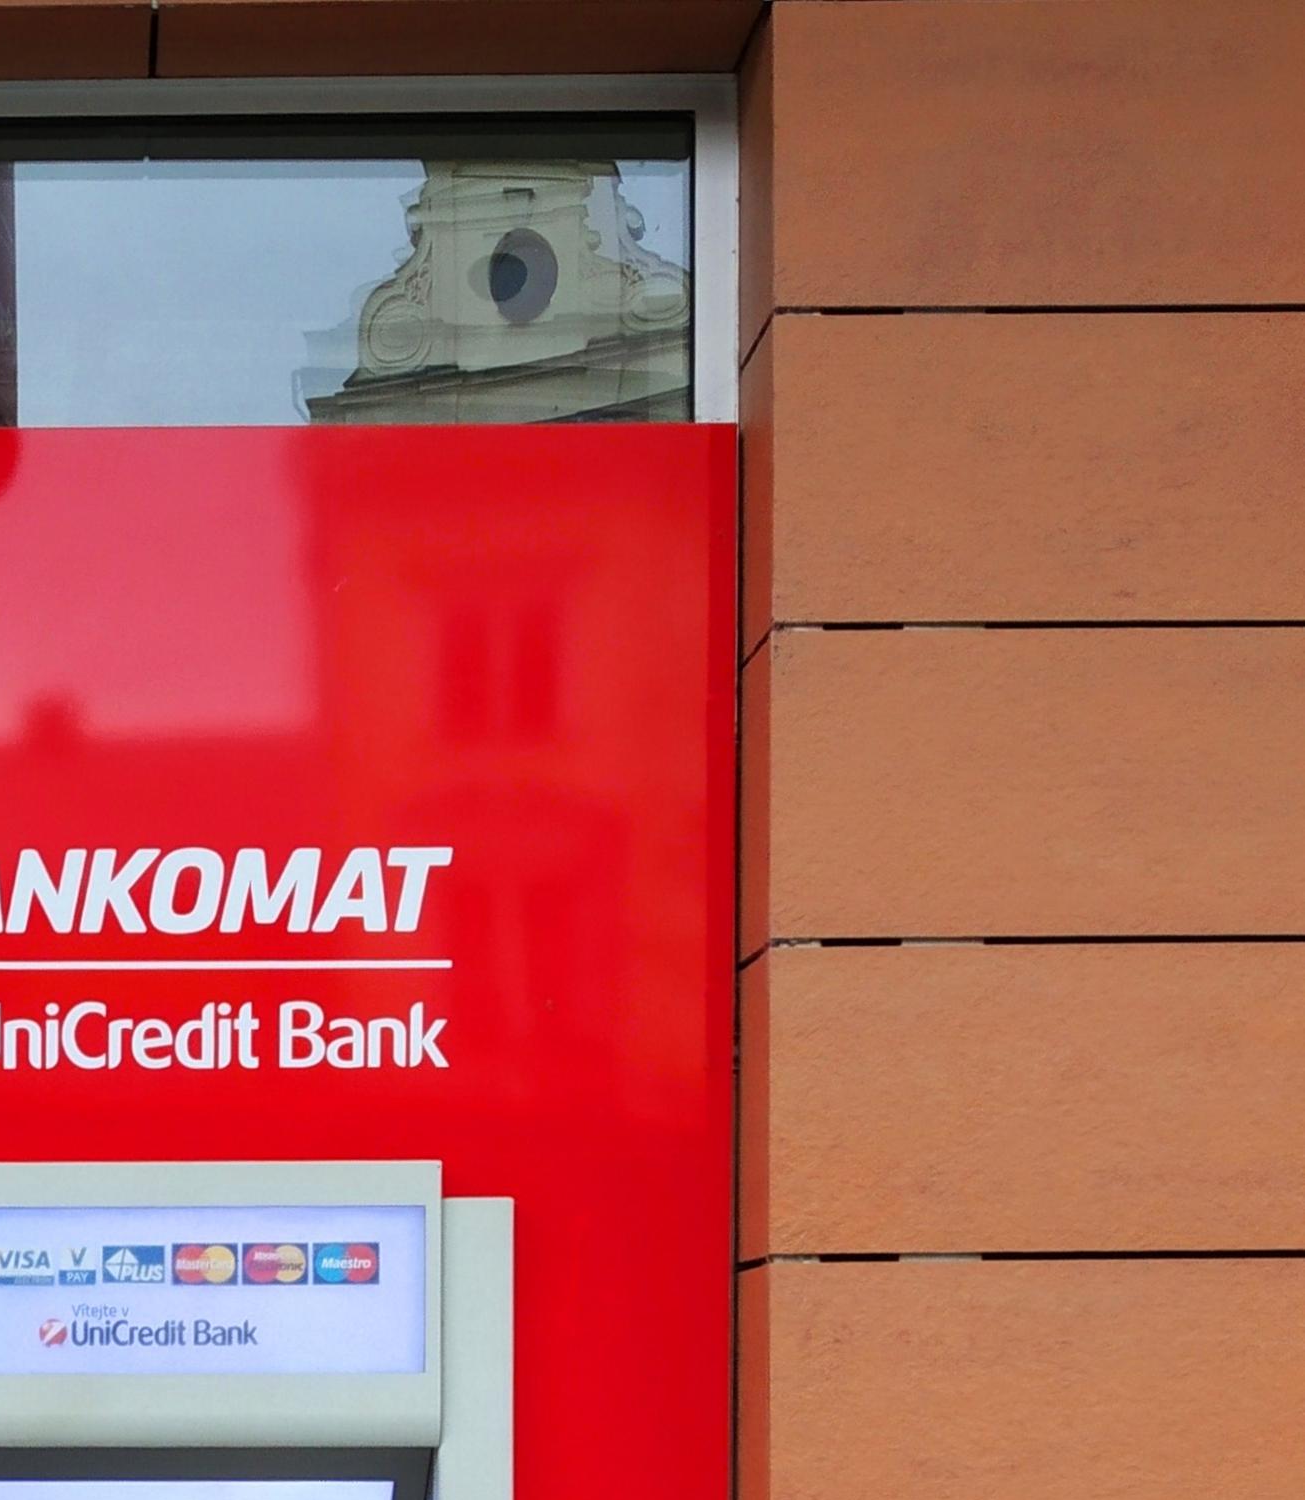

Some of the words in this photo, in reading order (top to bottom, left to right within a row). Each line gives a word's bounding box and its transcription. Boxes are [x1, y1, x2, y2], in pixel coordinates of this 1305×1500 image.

[279, 1001, 450, 1069] Bank
[69, 1247, 87, 1266] V
[321, 1257, 371, 1269] Maestro
[66, 1271, 89, 1283] PAY
[122, 1264, 164, 1282] PLUS
[121, 1307, 129, 1317] v
[71, 1319, 186, 1347] UniCredit
[194, 1319, 258, 1346] Bank
